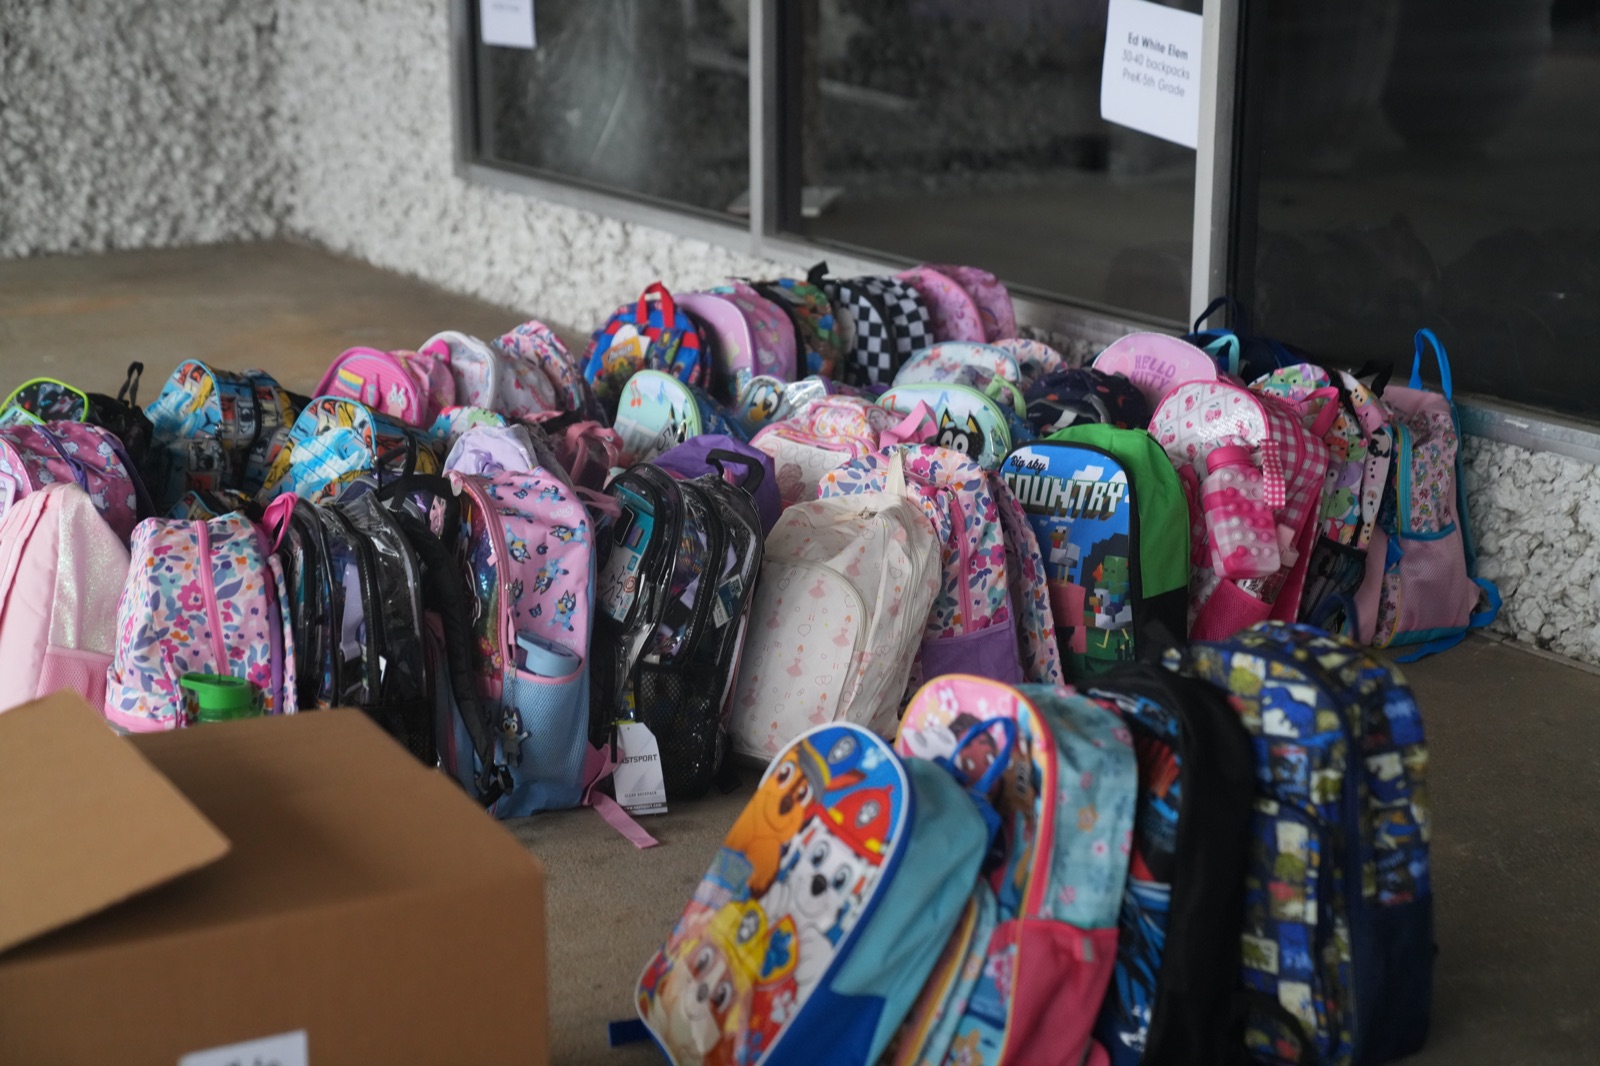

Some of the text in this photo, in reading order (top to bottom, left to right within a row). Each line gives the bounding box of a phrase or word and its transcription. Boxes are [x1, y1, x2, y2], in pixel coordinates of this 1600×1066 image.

[1128, 31, 1188, 60] Ed White Elem
[1146, 57, 1190, 80] backpacks
[1158, 79, 1184, 97] Grade
[1135, 355, 1176, 378] HELLO
[1130, 370, 1171, 390] KITTY
[1010, 455, 1047, 475] Big sky
[620, 754, 658, 764] ASTSPORT
